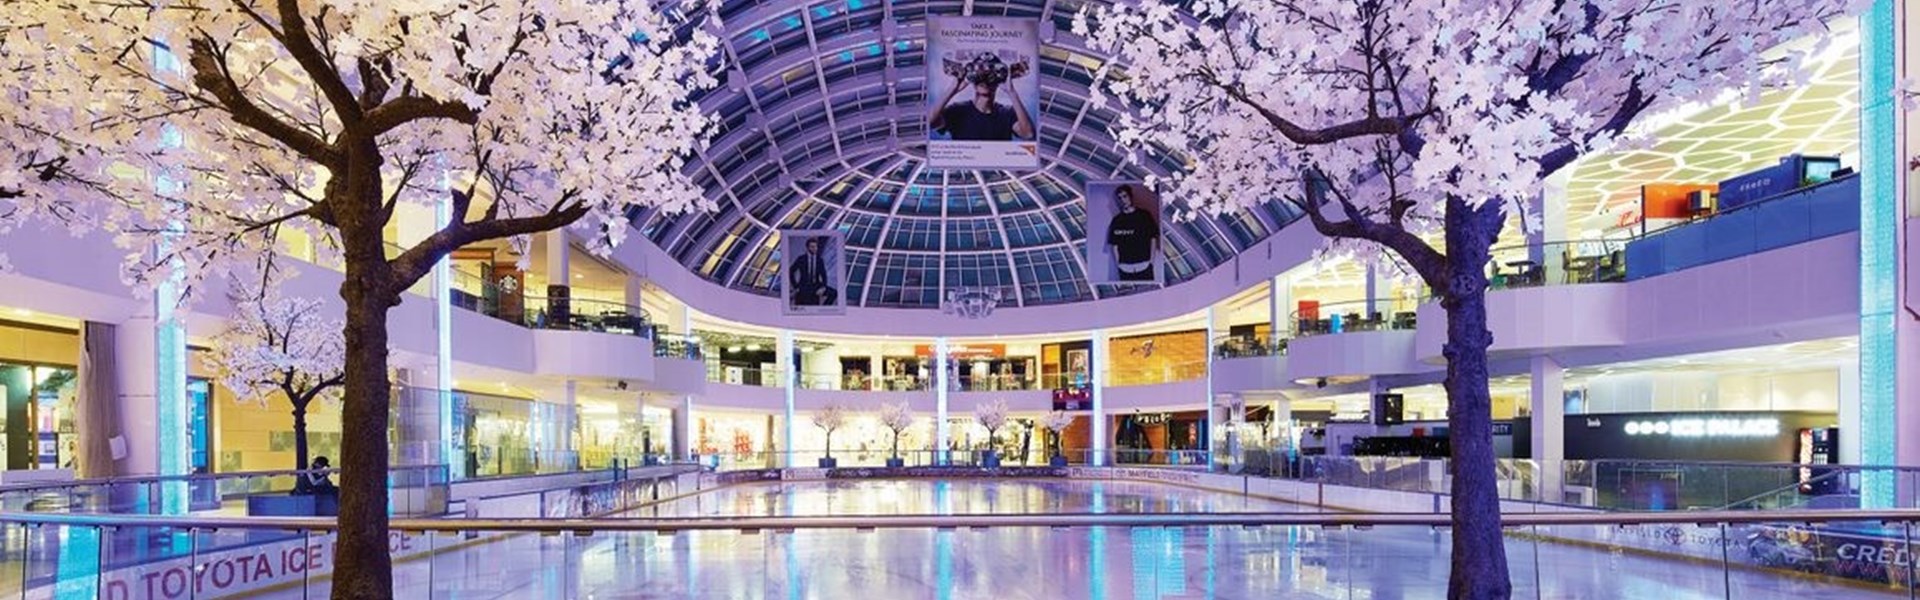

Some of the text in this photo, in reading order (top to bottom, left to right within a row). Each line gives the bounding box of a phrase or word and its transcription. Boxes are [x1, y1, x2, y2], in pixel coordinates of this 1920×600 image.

[989, 30, 1023, 38] JOURNEY
[1669, 419, 1780, 436] ICE PALACE
[1836, 543, 1920, 568] CRED
[143, 553, 273, 600] TOYOTA
[281, 544, 323, 576] ICE
